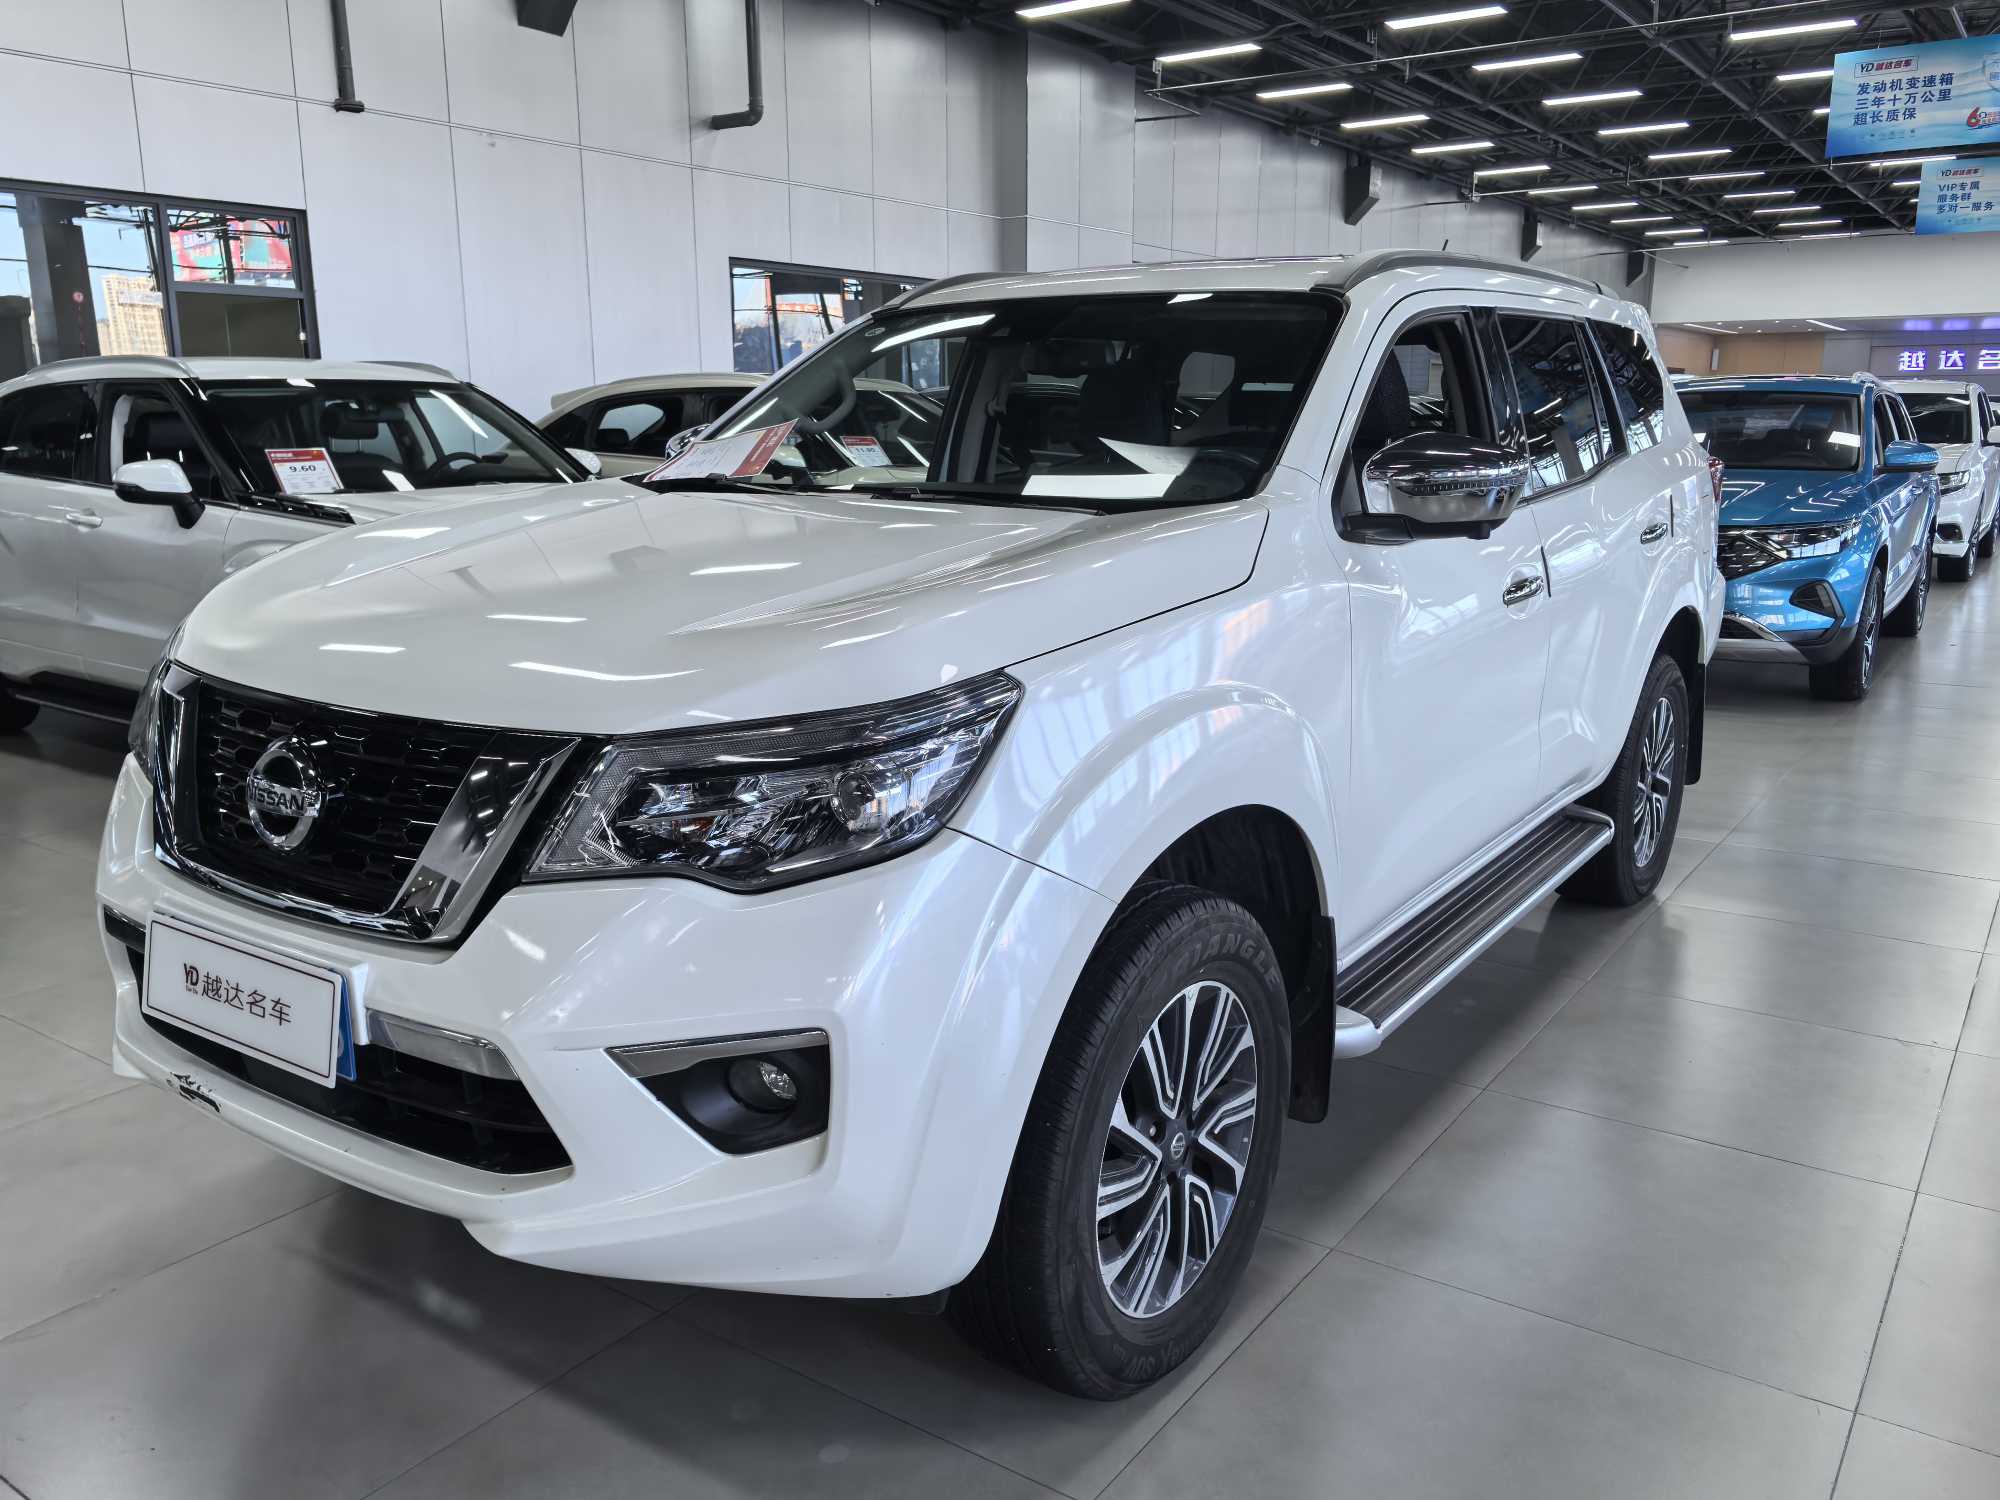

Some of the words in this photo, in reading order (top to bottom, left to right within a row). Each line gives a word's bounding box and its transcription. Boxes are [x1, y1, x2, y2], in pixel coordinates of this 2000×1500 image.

[1860, 63, 1875, 73] YD
[1856, 73, 1955, 96] 发动机变速箱
[1855, 89, 1952, 111] 三年十万公里
[1853, 107, 1917, 126] 超长质保
[1936, 201, 1995, 214] 多对一服务
[289, 465, 316, 473] 9.60
[247, 782, 305, 811] NISSAN
[201, 971, 291, 1026] 越达名车
